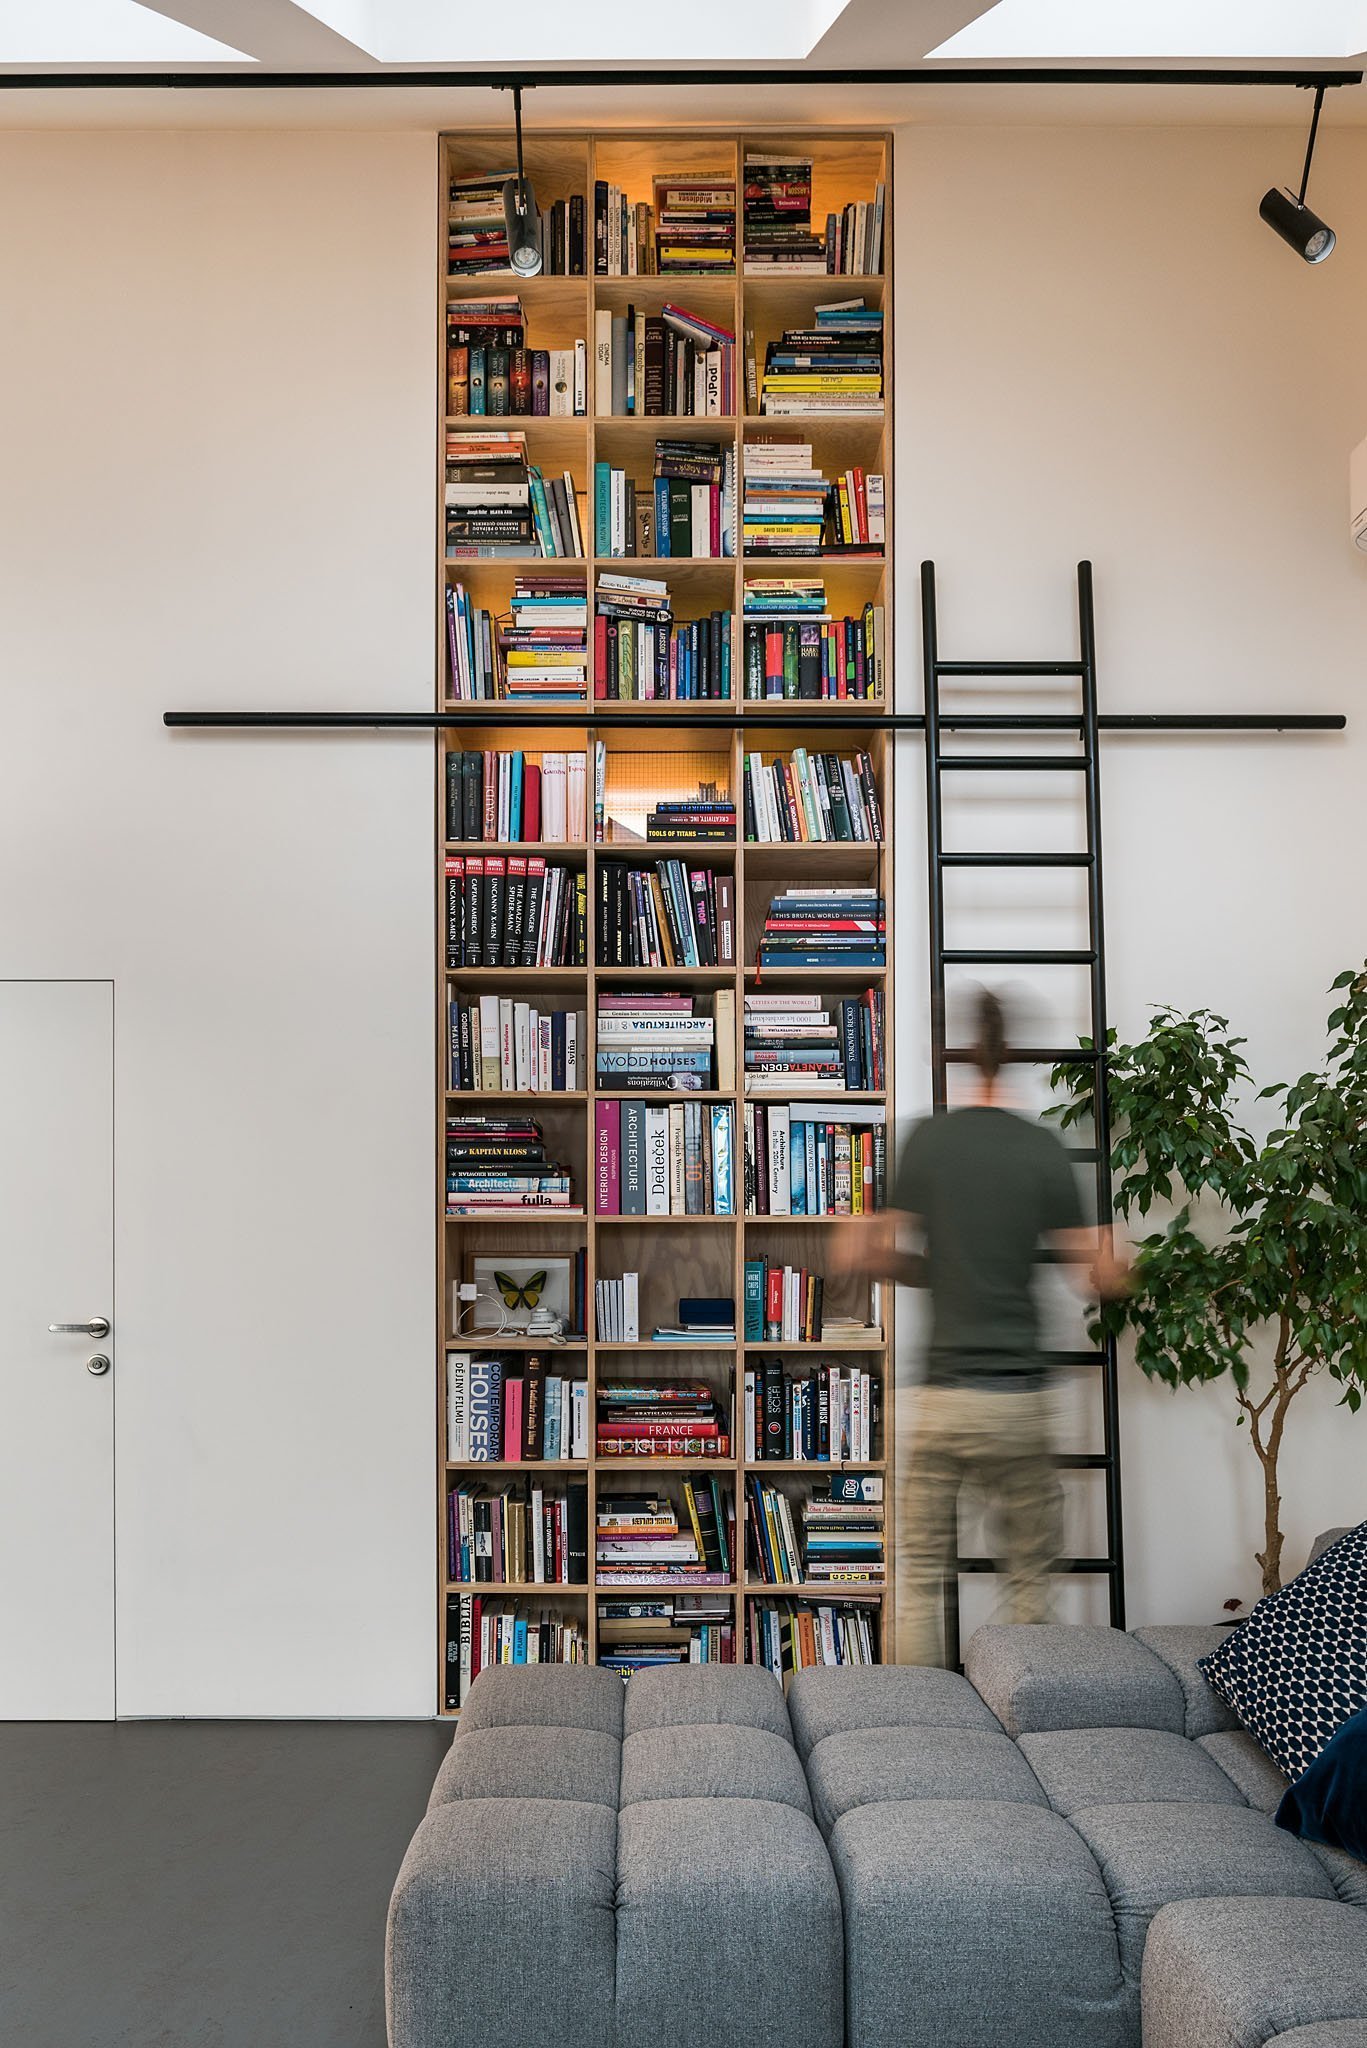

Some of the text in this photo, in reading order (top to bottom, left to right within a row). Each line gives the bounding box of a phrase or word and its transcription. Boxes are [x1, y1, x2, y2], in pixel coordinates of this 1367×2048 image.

[636, 343, 644, 373] Choroby
[709, 367, 718, 397] JPod
[679, 464, 700, 474] Magyk
[599, 481, 607, 525] ARCHITECTURE
[659, 629, 667, 654] LARSSON
[828, 757, 838, 783] LARSSON
[790, 805, 798, 829] HARFORD
[676, 882, 685, 912] ARCHITECTURE
[515, 899, 523, 934] AMAZING
[529, 902, 537, 932] AVENGERS
[697, 901, 706, 924] THOR
[632, 1021, 706, 1029] ARCHITEKTURA
[847, 1007, 855, 1062] STAROVĚKÉ ŘECKO
[567, 1039, 575, 1064] Sviňa
[602, 1057, 648, 1066] WOOD
[627, 1076, 678, 1089] Civilizations
[628, 1108, 637, 1191] ARCHITECTURE
[651, 1130, 664, 1195] Dedeček
[600, 1130, 608, 1208] INTERIOR DESIGN
[521, 1195, 552, 1205] fulla
[455, 1362, 465, 1424] DĚJINY FILMU
[773, 1386, 781, 1413] SCI-FI
[819, 1391, 828, 1424] ELON MUSK
[470, 1364, 488, 1461] HOUSES
[490, 1364, 500, 1462] CONTEMPORARY
[649, 1426, 693, 1435] FRANCE
[461, 1596, 471, 1644] BIBLIA
